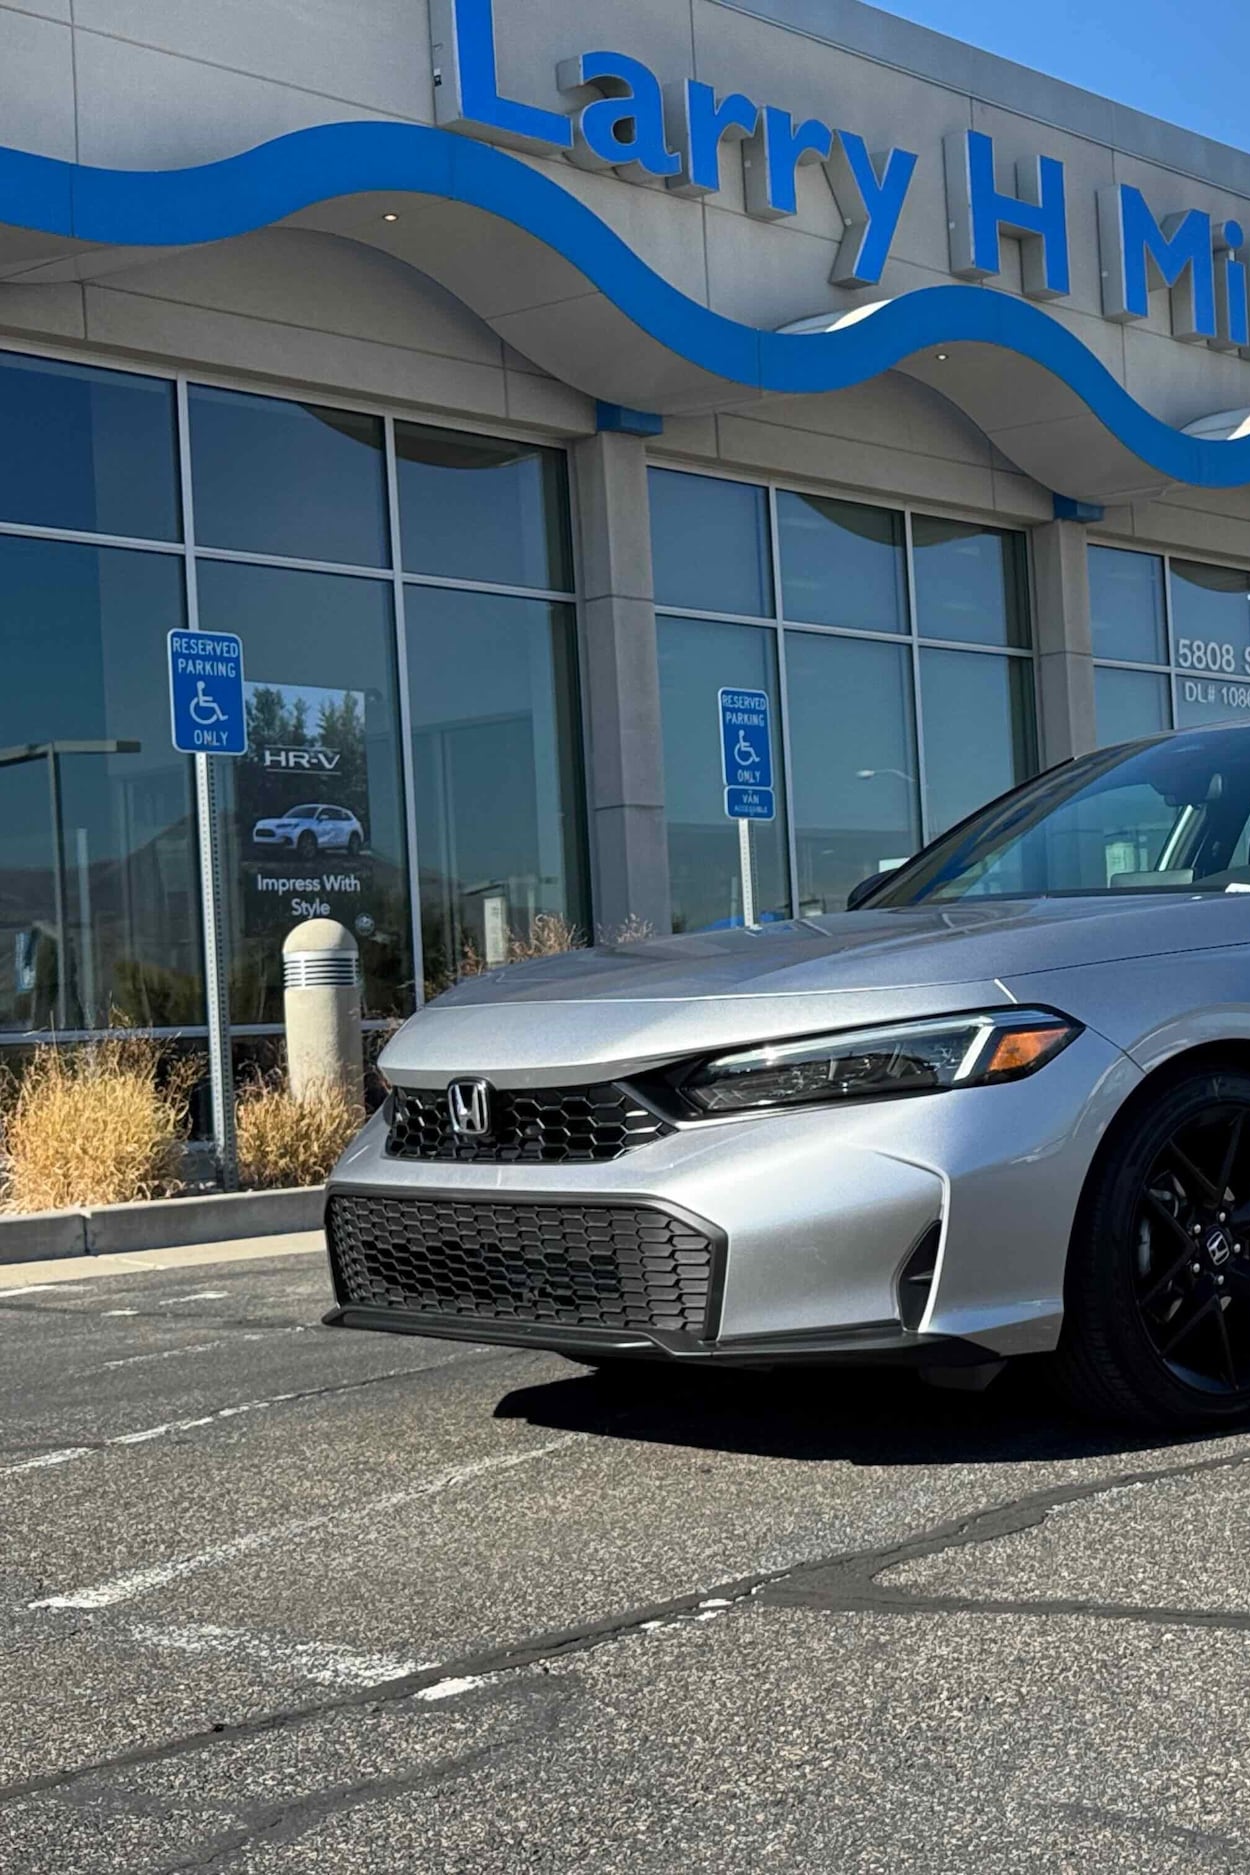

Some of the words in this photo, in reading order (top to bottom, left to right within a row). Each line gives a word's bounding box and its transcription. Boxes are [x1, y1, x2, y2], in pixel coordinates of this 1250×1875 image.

[450, 0, 919, 285] Larry
[966, 128, 1071, 297] H
[172, 637, 239, 658] RESERVED
[1179, 638, 1236, 672] 5808
[178, 658, 237, 678] PARKING
[1184, 681, 1216, 703] DL#
[721, 694, 767, 711] RESERVED
[725, 711, 765, 726] PARKING
[193, 729, 229, 747] ONLY
[264, 750, 341, 770] HR-V
[737, 769, 761, 784] ONLY
[742, 793, 760, 805] VAN
[257, 874, 321, 895] Impress
[322, 875, 361, 892] With
[291, 897, 332, 919] Style
